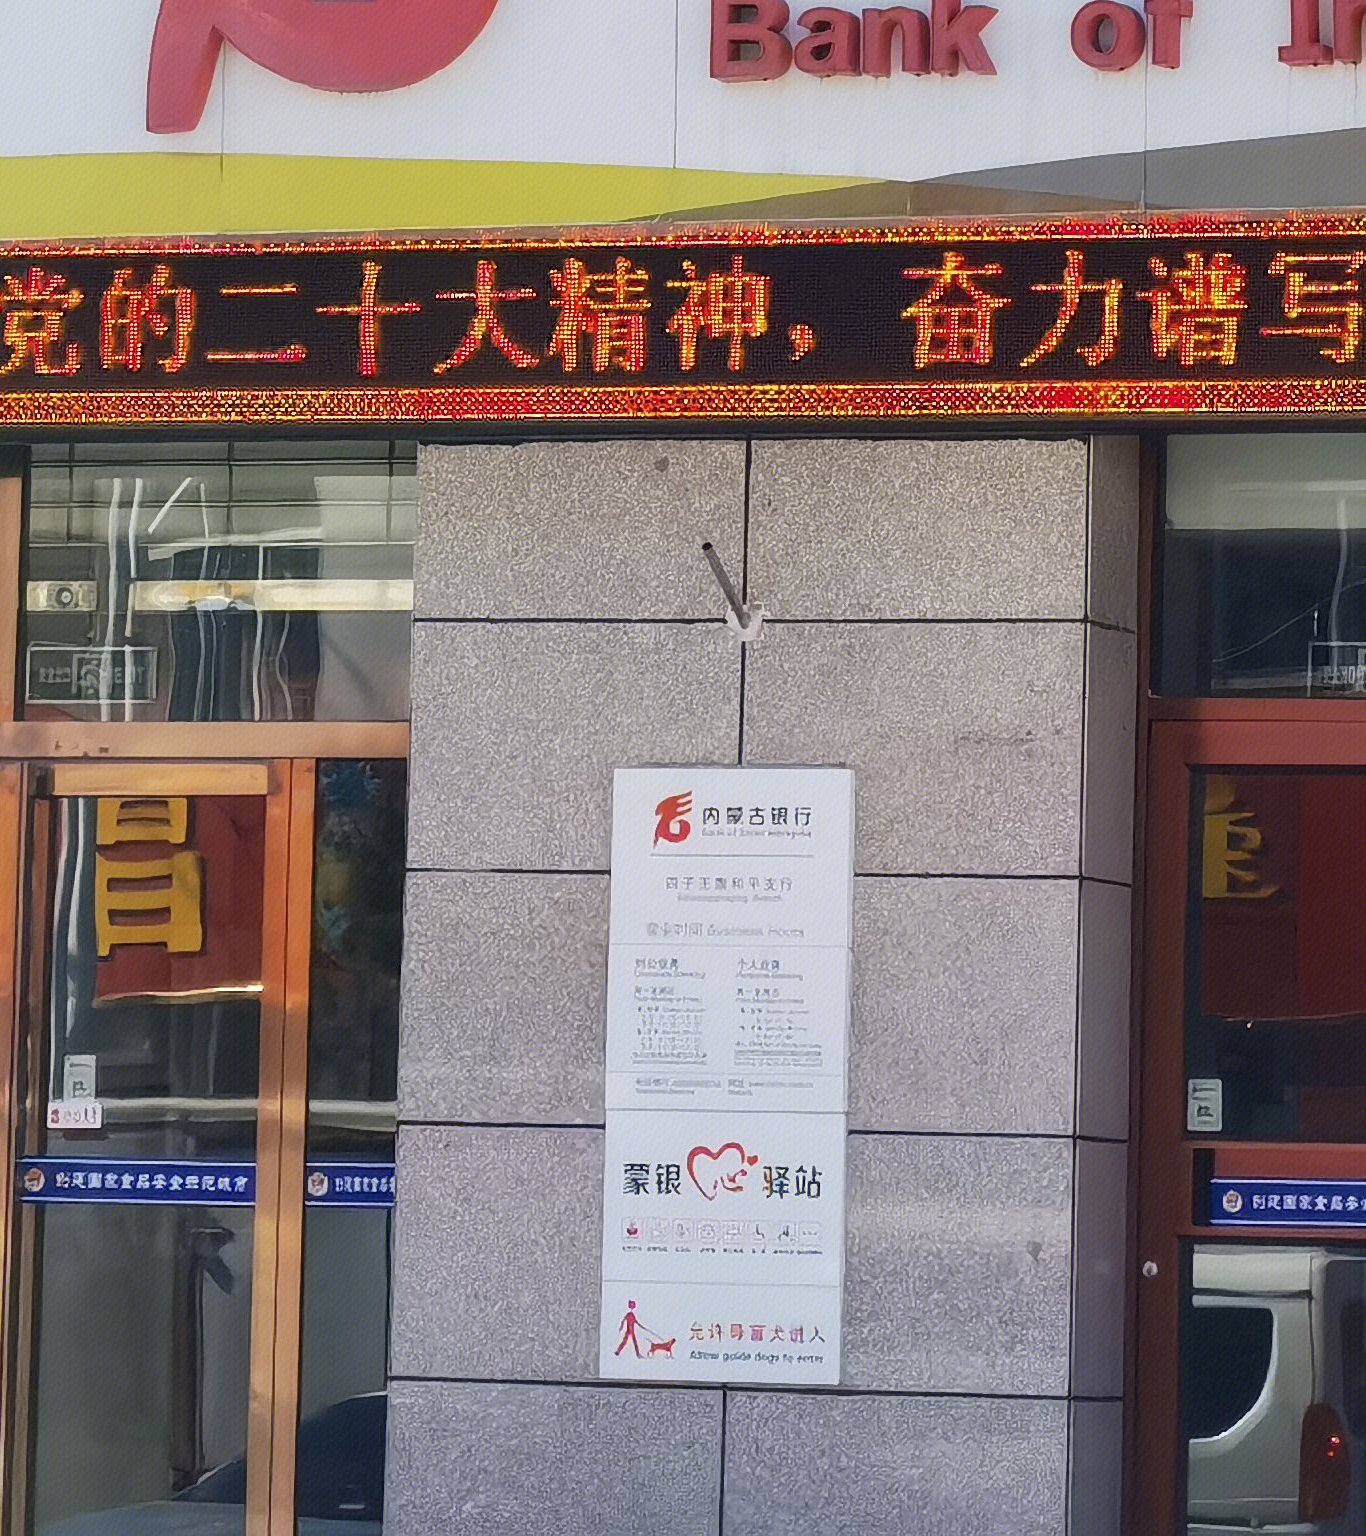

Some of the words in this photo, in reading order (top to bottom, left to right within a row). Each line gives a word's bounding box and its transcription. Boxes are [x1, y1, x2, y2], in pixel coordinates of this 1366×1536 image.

[702, 806, 812, 826] 内蒙古银行
[622, 1163, 682, 1195] 蒙银
[762, 1165, 823, 1199] 驿站
